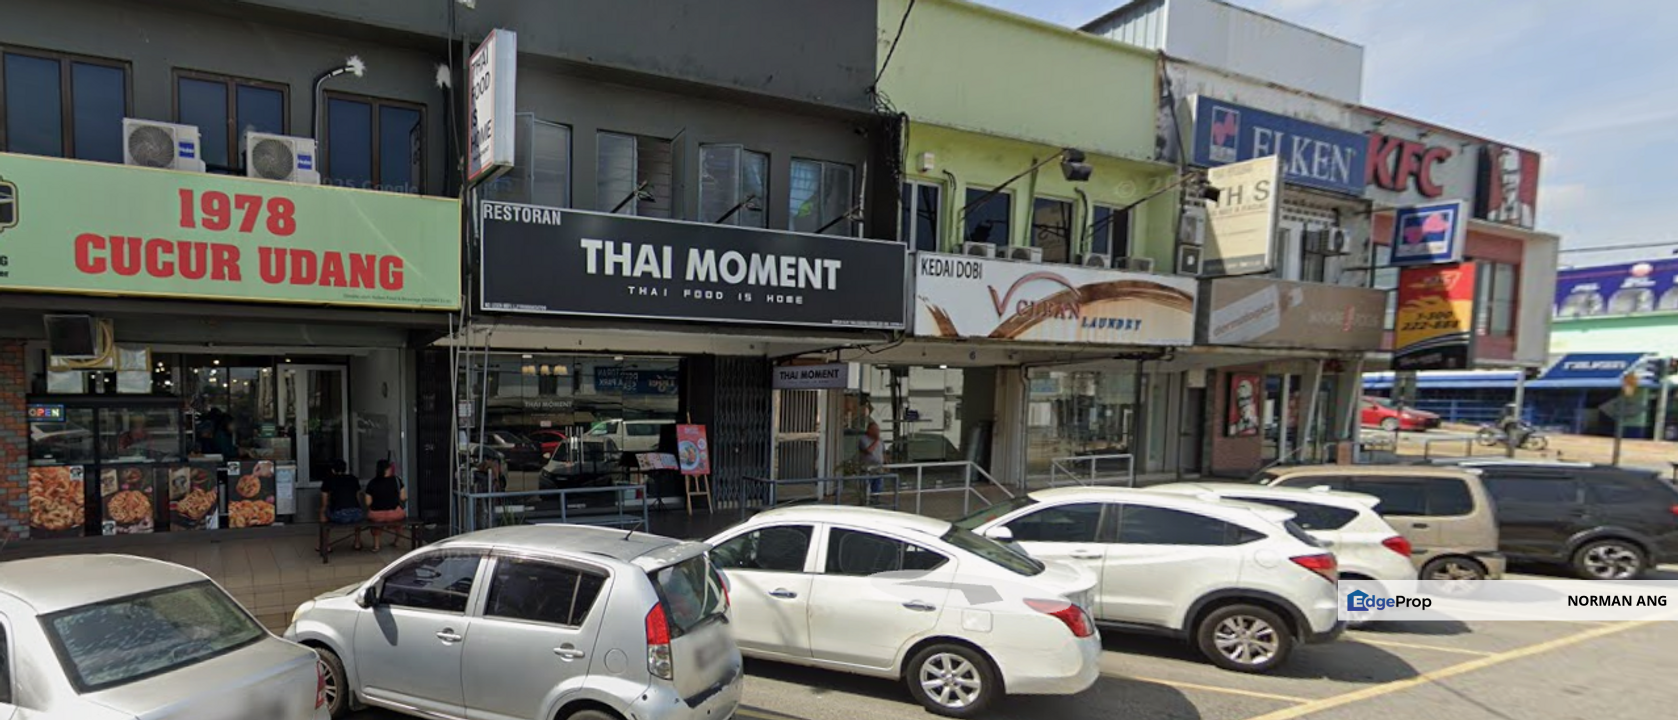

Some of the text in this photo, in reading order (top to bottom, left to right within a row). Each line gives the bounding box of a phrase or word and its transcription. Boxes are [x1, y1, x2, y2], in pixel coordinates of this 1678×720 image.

[471, 47, 489, 75] THAI
[472, 71, 491, 100] FOOD
[1253, 126, 1355, 184] ELKEN
[1366, 133, 1453, 199] KFC
[1213, 178, 1270, 209] THS
[178, 188, 297, 236] 1978
[483, 204, 562, 226] RESTORAN
[73, 233, 404, 291] CUCUR UDANG
[580, 238, 842, 290] THAI MOMENT
[922, 258, 982, 280] KEDAI DOBI
[627, 285, 668, 297] THAI
[683, 289, 724, 300] FOOD
[738, 292, 752, 302] IS
[1016, 299, 1081, 320] CLEAN
[1081, 318, 1142, 331] LAUNDRY
[780, 369, 839, 380] THAI MOMENT
[28, 407, 60, 417] OPEN
